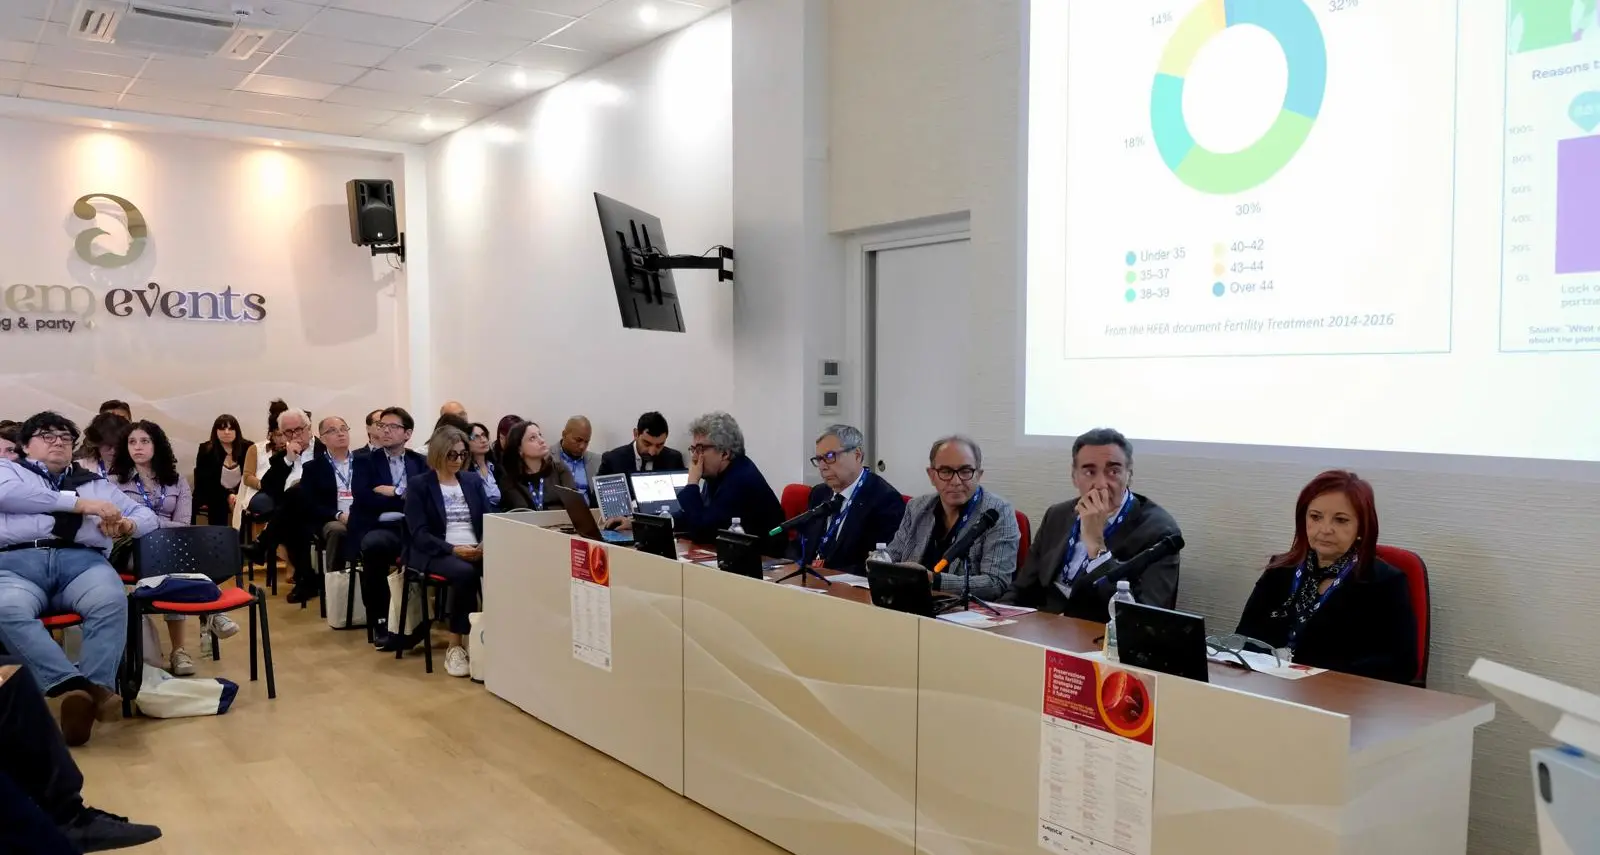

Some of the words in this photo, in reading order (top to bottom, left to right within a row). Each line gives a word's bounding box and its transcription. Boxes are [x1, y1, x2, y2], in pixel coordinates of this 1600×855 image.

[1150, 11, 1173, 27] 14%
[1532, 63, 1590, 80] Reasons
[1123, 135, 1146, 150] 18%
[1235, 201, 1262, 216] 30%
[1140, 249, 1170, 262] Under
[1173, 247, 1186, 259] 35
[1230, 281, 1256, 294] Over
[1259, 280, 1274, 291] 44
[1561, 283, 1589, 294] Lack
[1593, 284, 1600, 293] o
[0, 283, 97, 323] em
[104, 282, 267, 321] events
[18, 317, 29, 329] &
[35, 317, 77, 332] party
[1104, 324, 1127, 336] From
[1129, 324, 1144, 336] the
[1146, 322, 1170, 335] HFEA
[1173, 320, 1222, 334] document
[1223, 318, 1264, 333] Fertility
[1267, 316, 1325, 330] Treatment
[1327, 312, 1395, 328] 2014-2016
